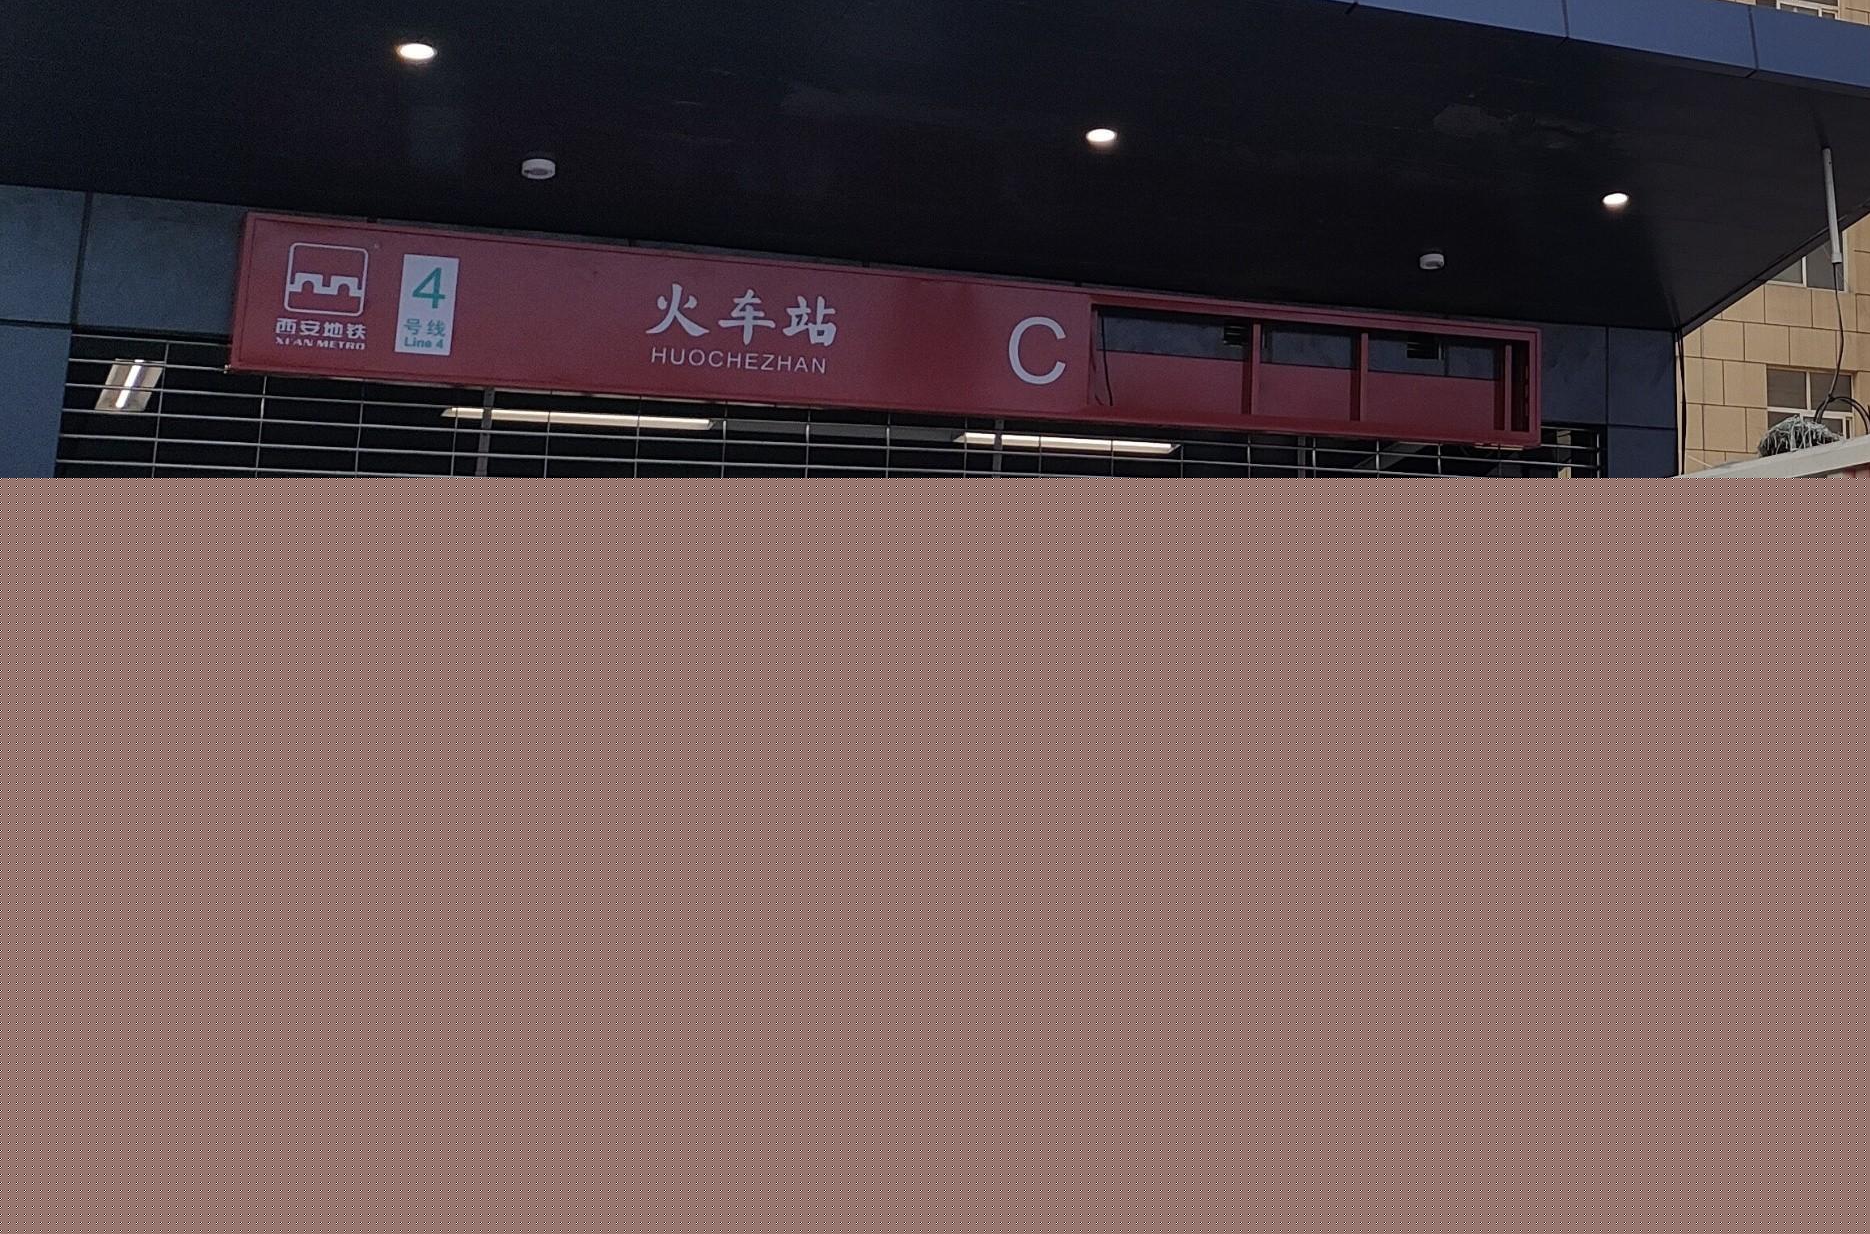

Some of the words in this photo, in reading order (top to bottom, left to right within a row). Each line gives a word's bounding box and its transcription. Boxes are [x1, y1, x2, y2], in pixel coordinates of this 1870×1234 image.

[412, 267, 446, 309] 4
[404, 318, 446, 337] 号线
[645, 283, 837, 347] 火车站
[275, 317, 367, 341] 西安地铁
[316, 339, 366, 351] METRO
[404, 336, 432, 349] Line
[436, 339, 444, 350] 4
[1007, 316, 1066, 385] C
[651, 347, 827, 374] HUOCHEZHAN
